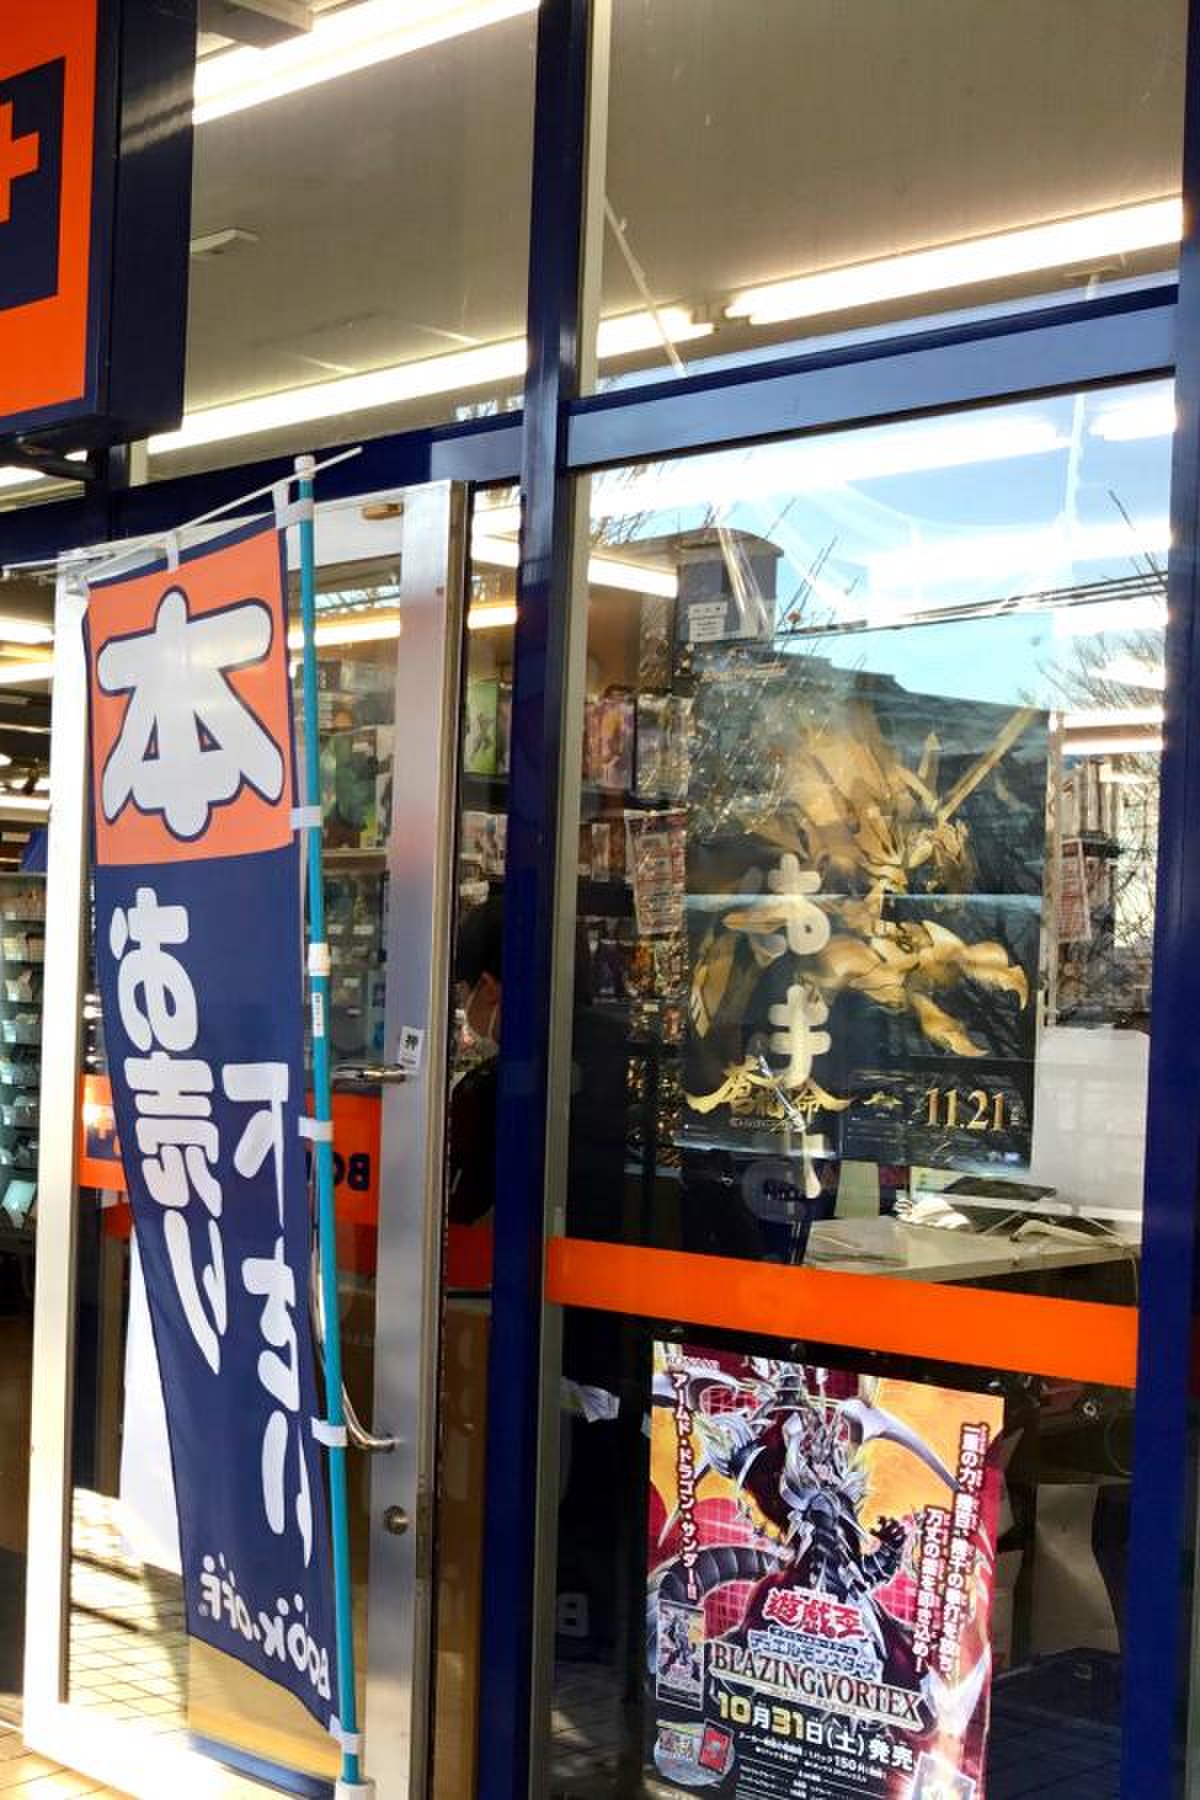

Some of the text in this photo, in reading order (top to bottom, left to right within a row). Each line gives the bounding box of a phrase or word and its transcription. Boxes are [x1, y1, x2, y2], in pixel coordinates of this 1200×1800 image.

[97, 585, 284, 843] 本
[714, 1643, 919, 1724] BLAZING VORTEX
